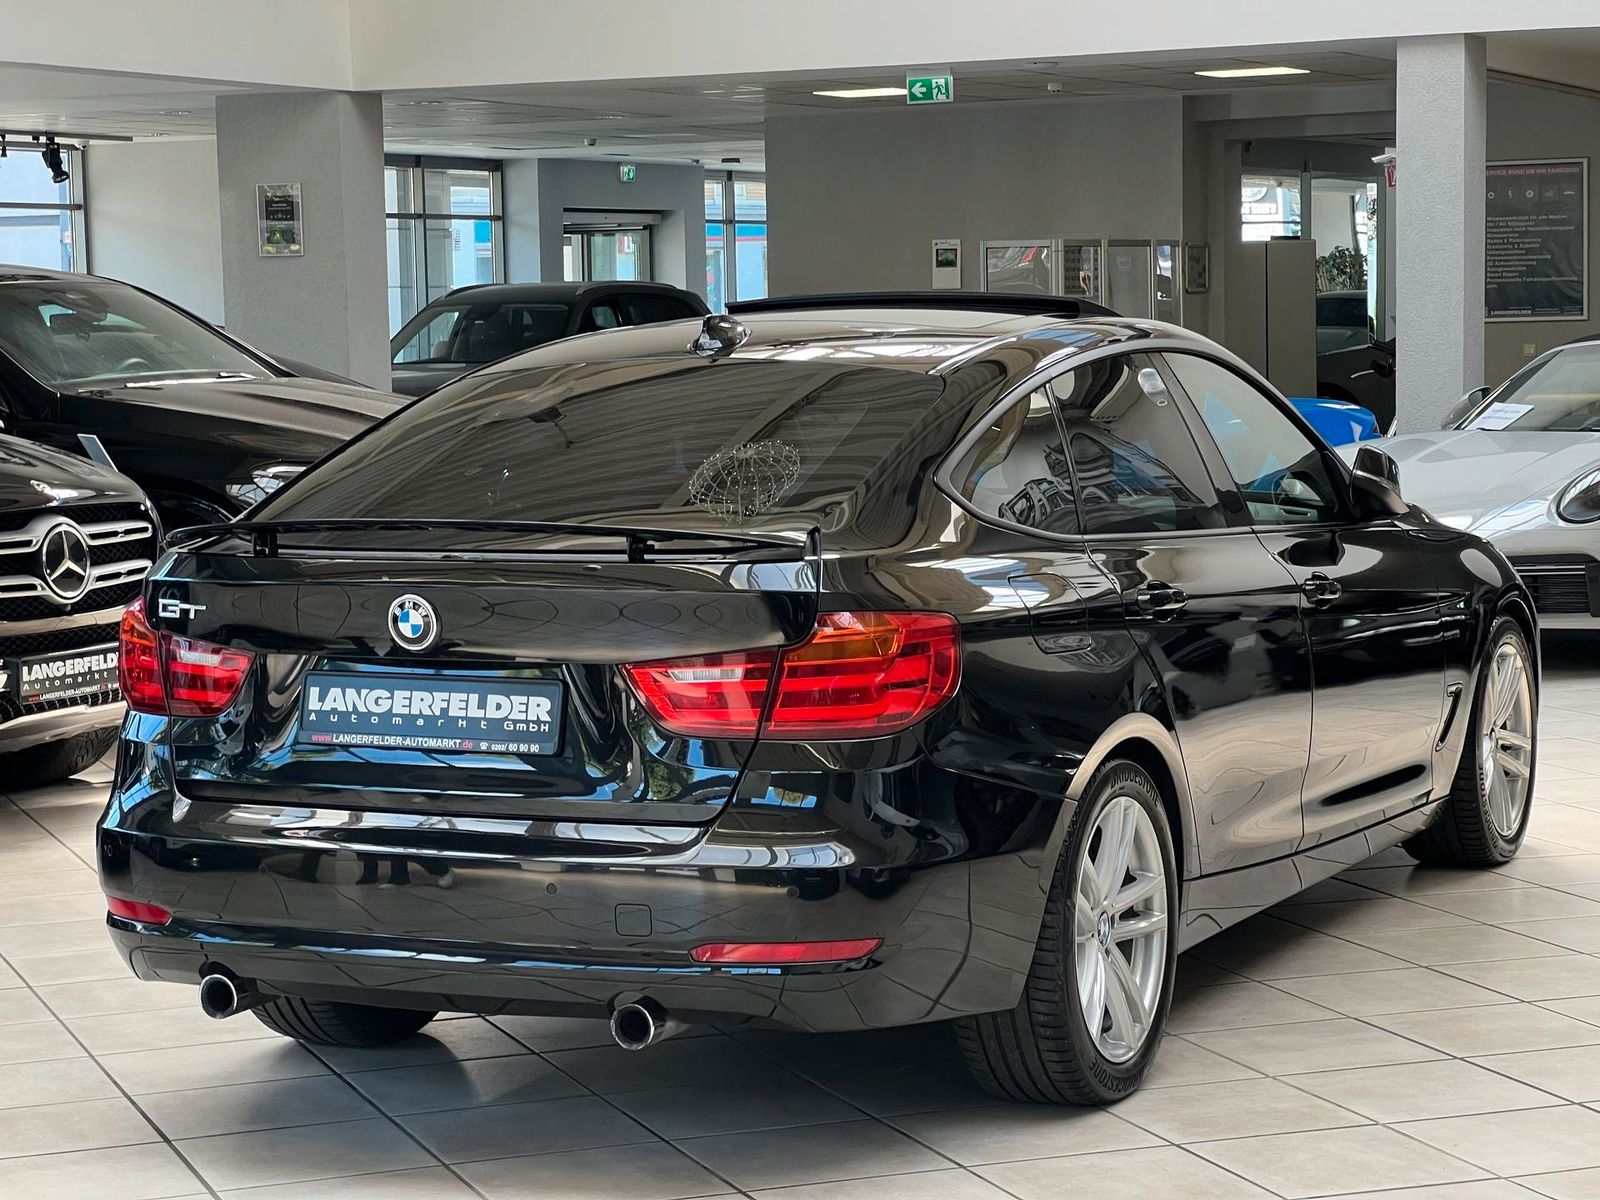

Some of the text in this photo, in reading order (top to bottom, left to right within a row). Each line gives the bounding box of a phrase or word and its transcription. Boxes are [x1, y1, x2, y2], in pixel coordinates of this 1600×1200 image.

[158, 598, 207, 619] GT
[394, 600, 428, 617] BMW
[22, 652, 119, 682] LANGERFELD
[23, 672, 108, 691] Automarkt
[308, 686, 552, 722] LANGERFELDER
[504, 720, 549, 733] GmbH
[508, 742, 518, 752] 60
[519, 743, 529, 753] 90
[530, 743, 540, 753] 90
[1110, 769, 1160, 808] BRIDGESTONE
